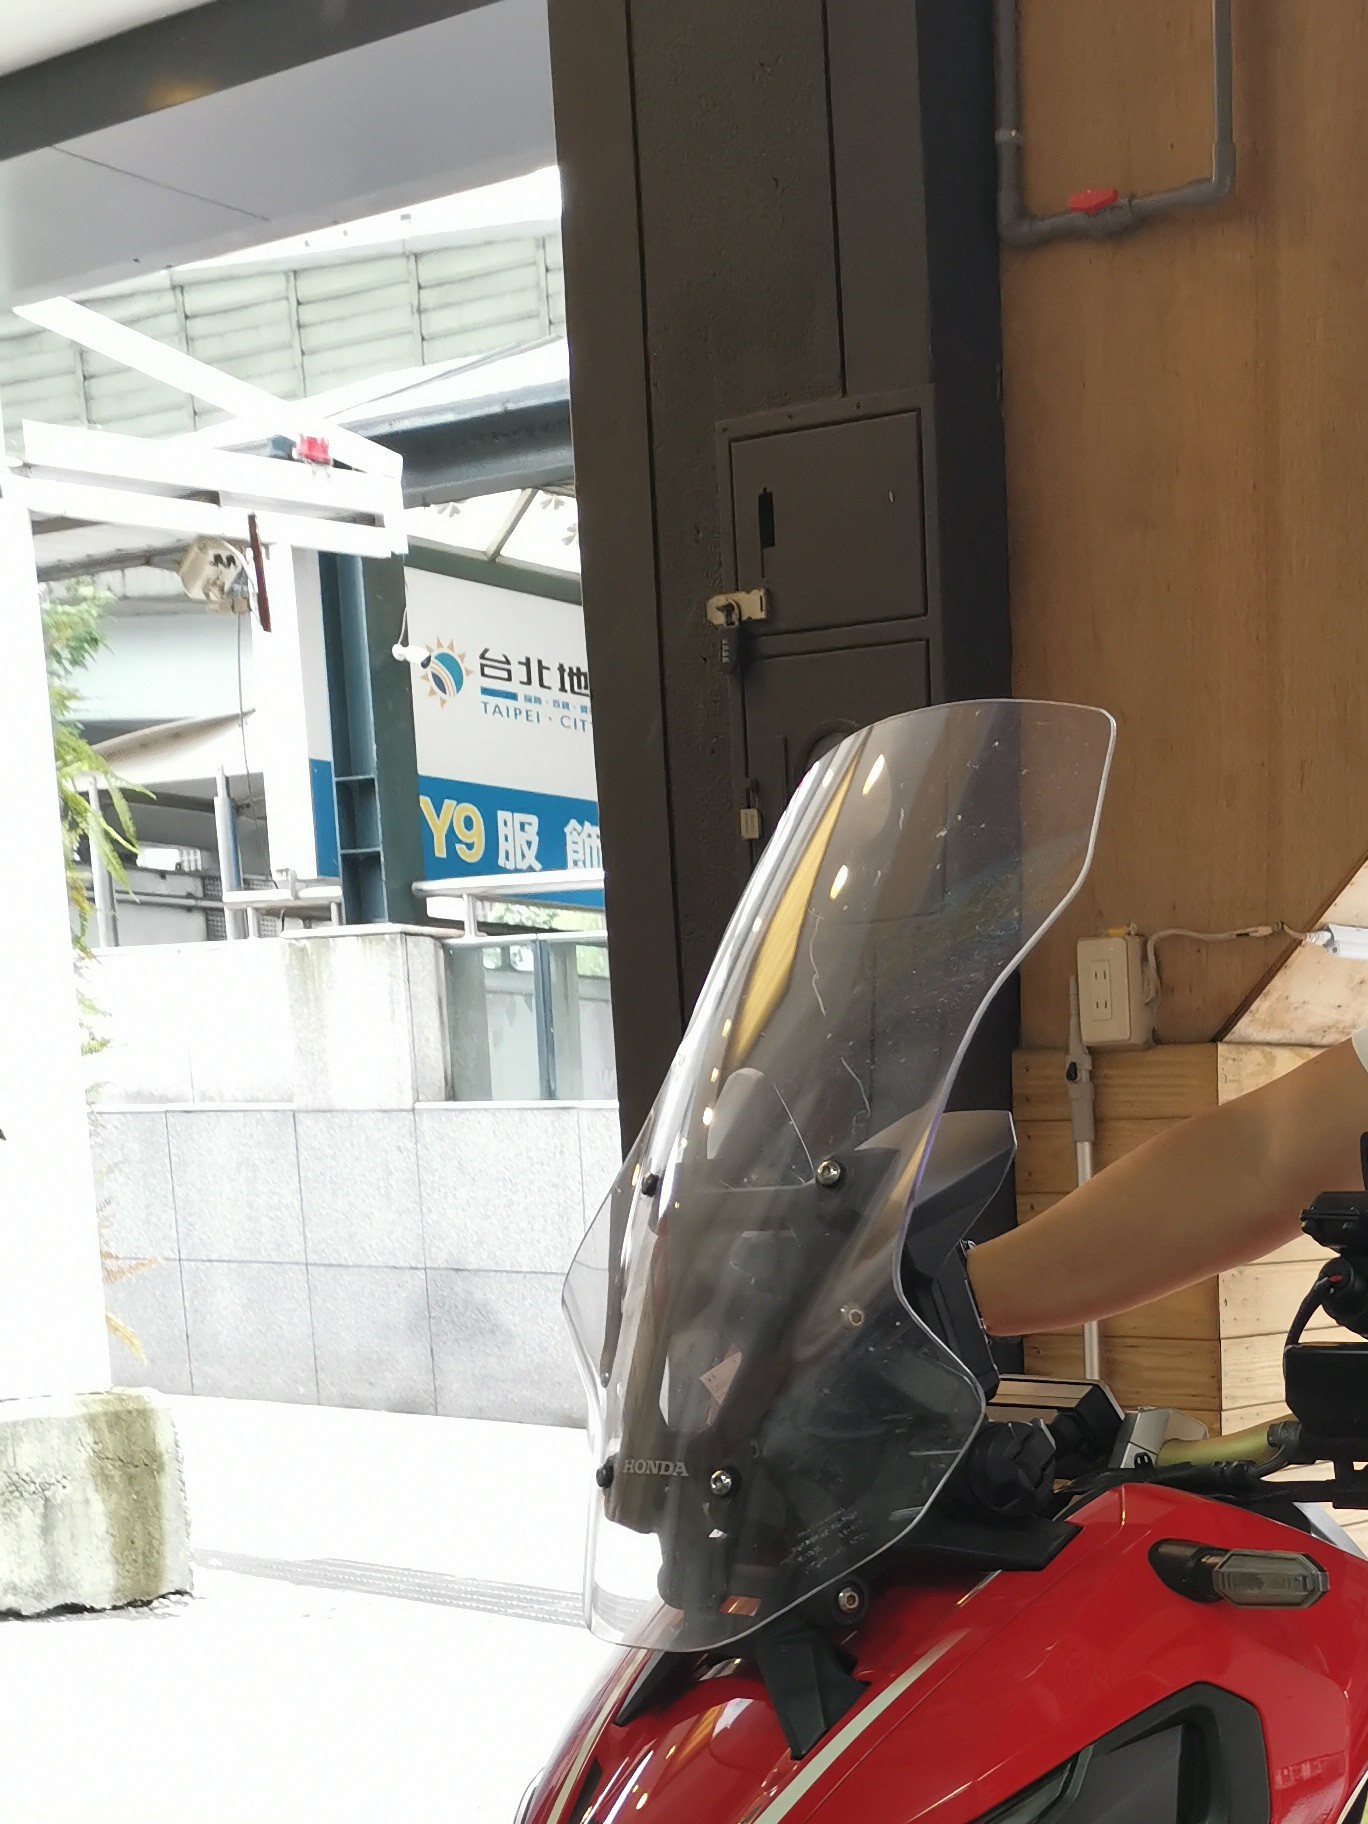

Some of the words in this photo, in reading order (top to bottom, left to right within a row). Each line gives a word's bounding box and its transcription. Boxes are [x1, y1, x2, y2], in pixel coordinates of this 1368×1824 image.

[481, 701, 541, 724] TAIPEI
[560, 715, 593, 733] CIT
[420, 795, 486, 864] Y9
[622, 1459, 690, 1477] HONDA
